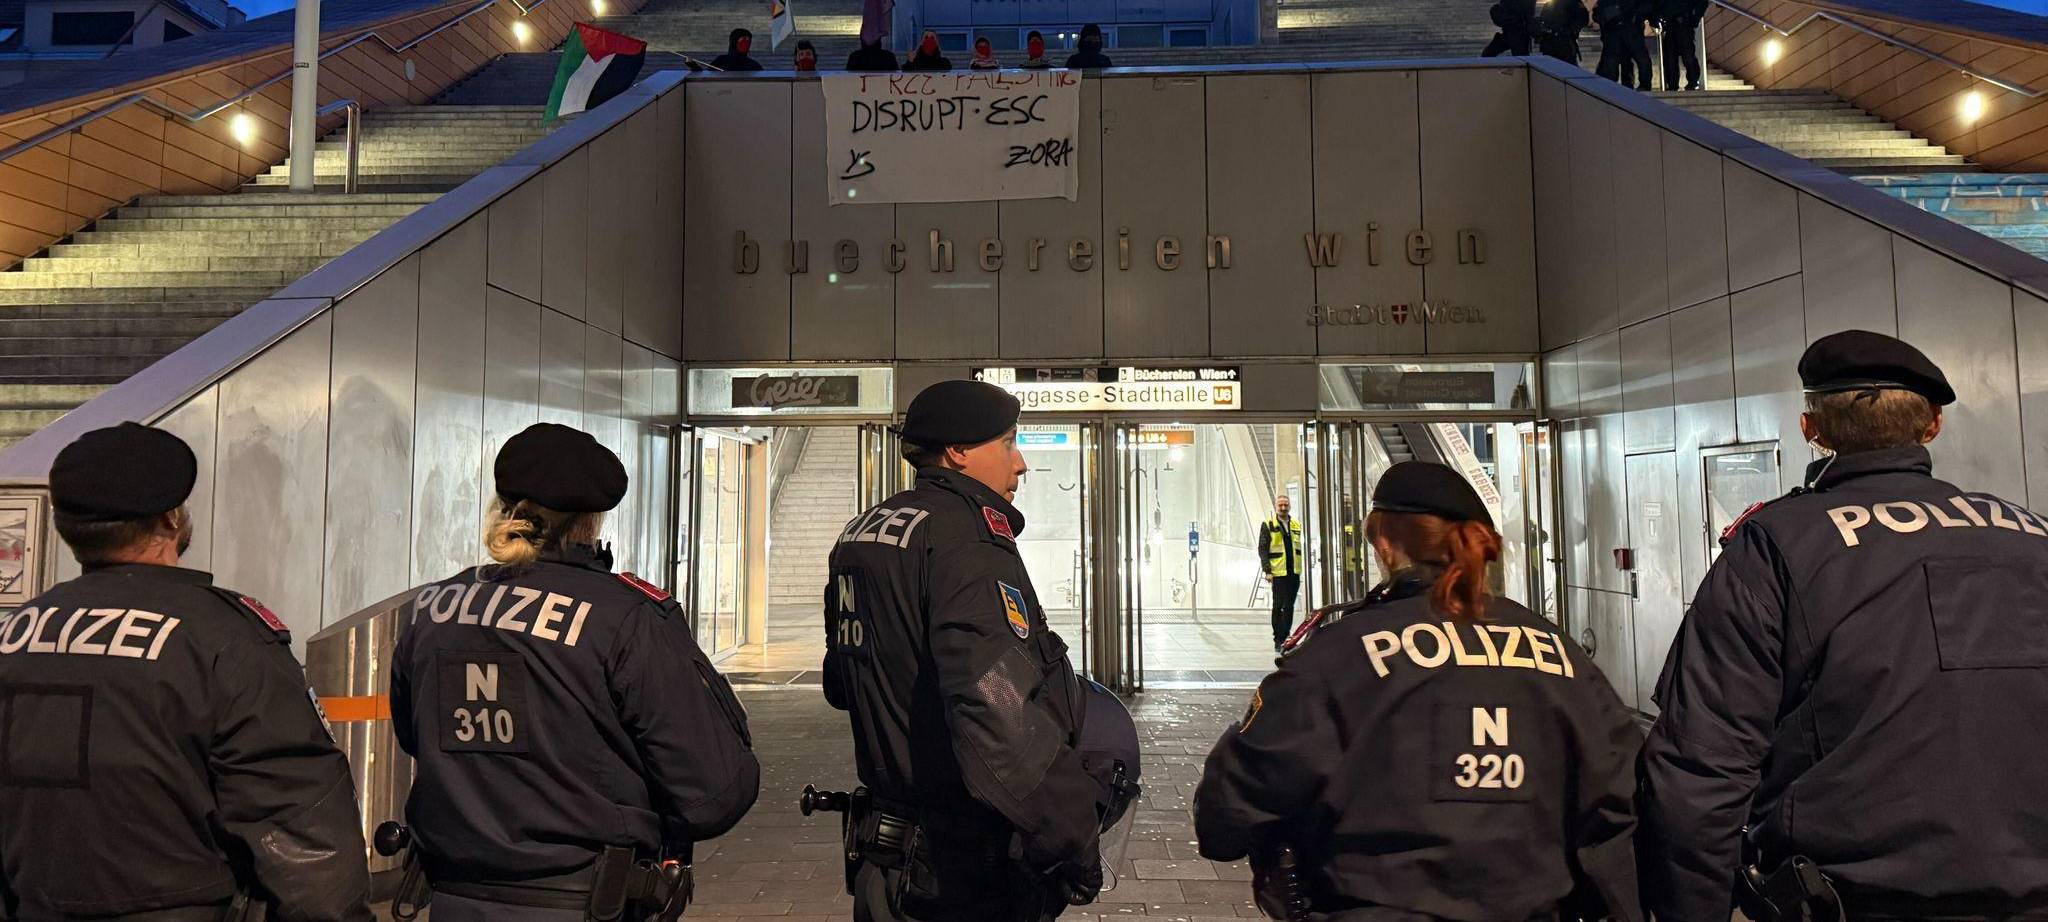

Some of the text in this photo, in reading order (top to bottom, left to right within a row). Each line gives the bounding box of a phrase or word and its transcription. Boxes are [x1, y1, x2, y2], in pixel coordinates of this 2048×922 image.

[1004, 137, 1073, 168] ZORA
[735, 221, 1485, 274] buechereien wien
[1411, 298, 1486, 325] Wien
[751, 371, 826, 411] Geier
[1200, 369, 1228, 380] Wien
[1012, 386, 1208, 408] ggasse-Stadthalle
[840, 507, 930, 549] LIZEI
[838, 575, 855, 612] N
[411, 583, 592, 647] POLIZEI
[837, 619, 863, 647] 10
[1362, 621, 1574, 678] POLIZEI
[466, 663, 498, 701] N
[453, 708, 514, 743] 310
[1472, 707, 1508, 746] N
[1455, 754, 1524, 789] 320
